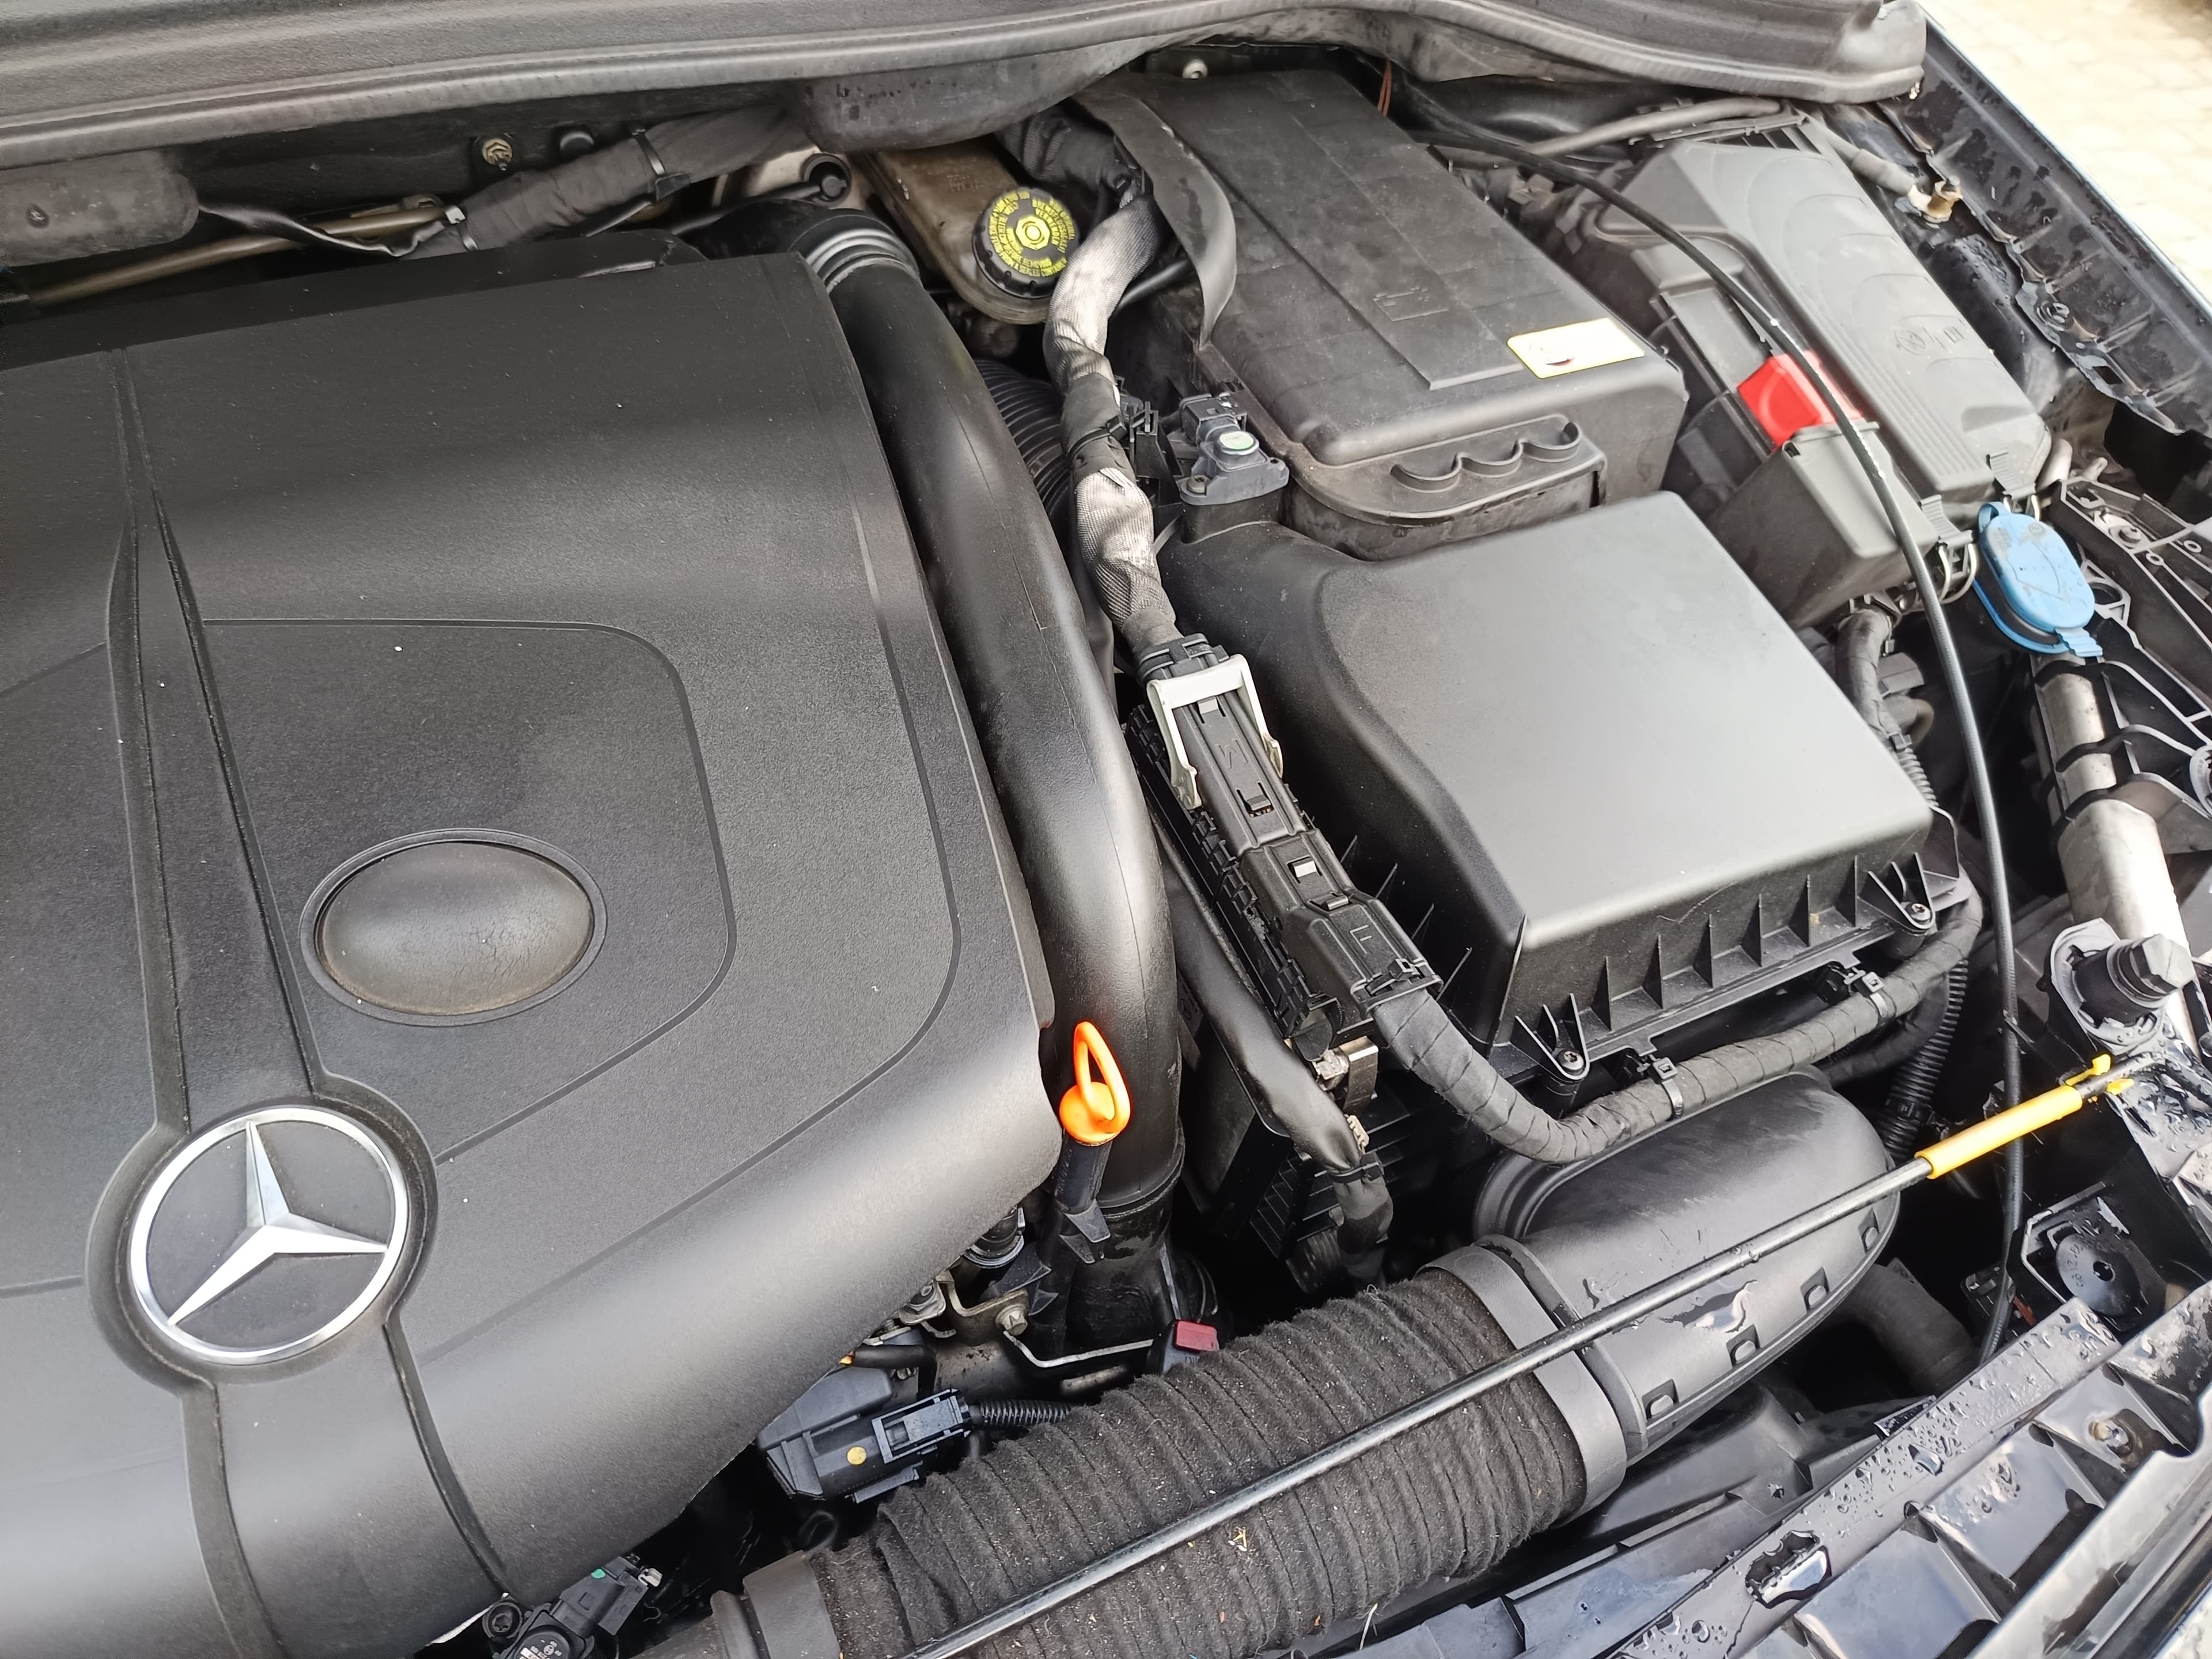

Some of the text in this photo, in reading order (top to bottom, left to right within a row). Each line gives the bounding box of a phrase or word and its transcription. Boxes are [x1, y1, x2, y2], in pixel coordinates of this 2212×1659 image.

[1035, 208, 1060, 246] VERWENDEN
[1060, 211, 1075, 240] ORIGINAL
[1349, 924, 1373, 955] F
